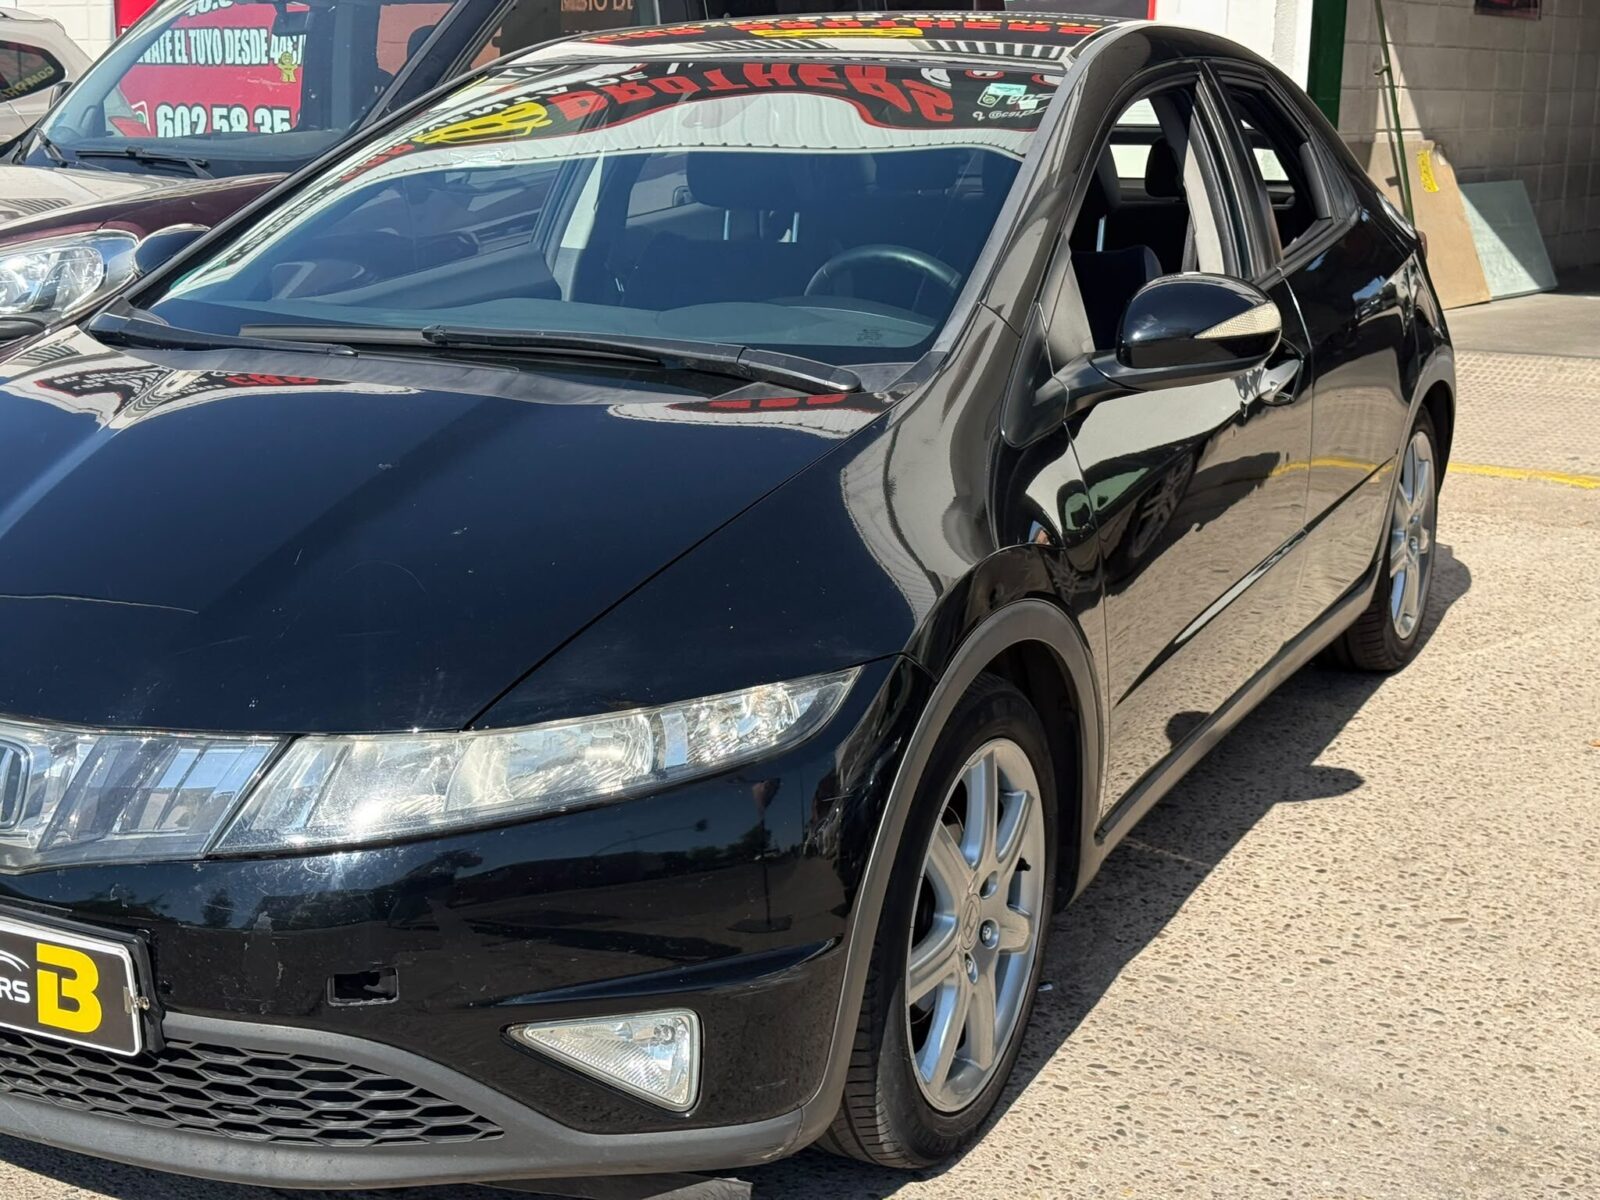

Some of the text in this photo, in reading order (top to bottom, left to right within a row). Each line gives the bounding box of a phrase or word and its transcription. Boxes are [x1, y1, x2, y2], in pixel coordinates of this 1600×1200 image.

[174, 29, 188, 64] EL
[188, 29, 222, 65] TUYO
[224, 29, 269, 65] DESDE
